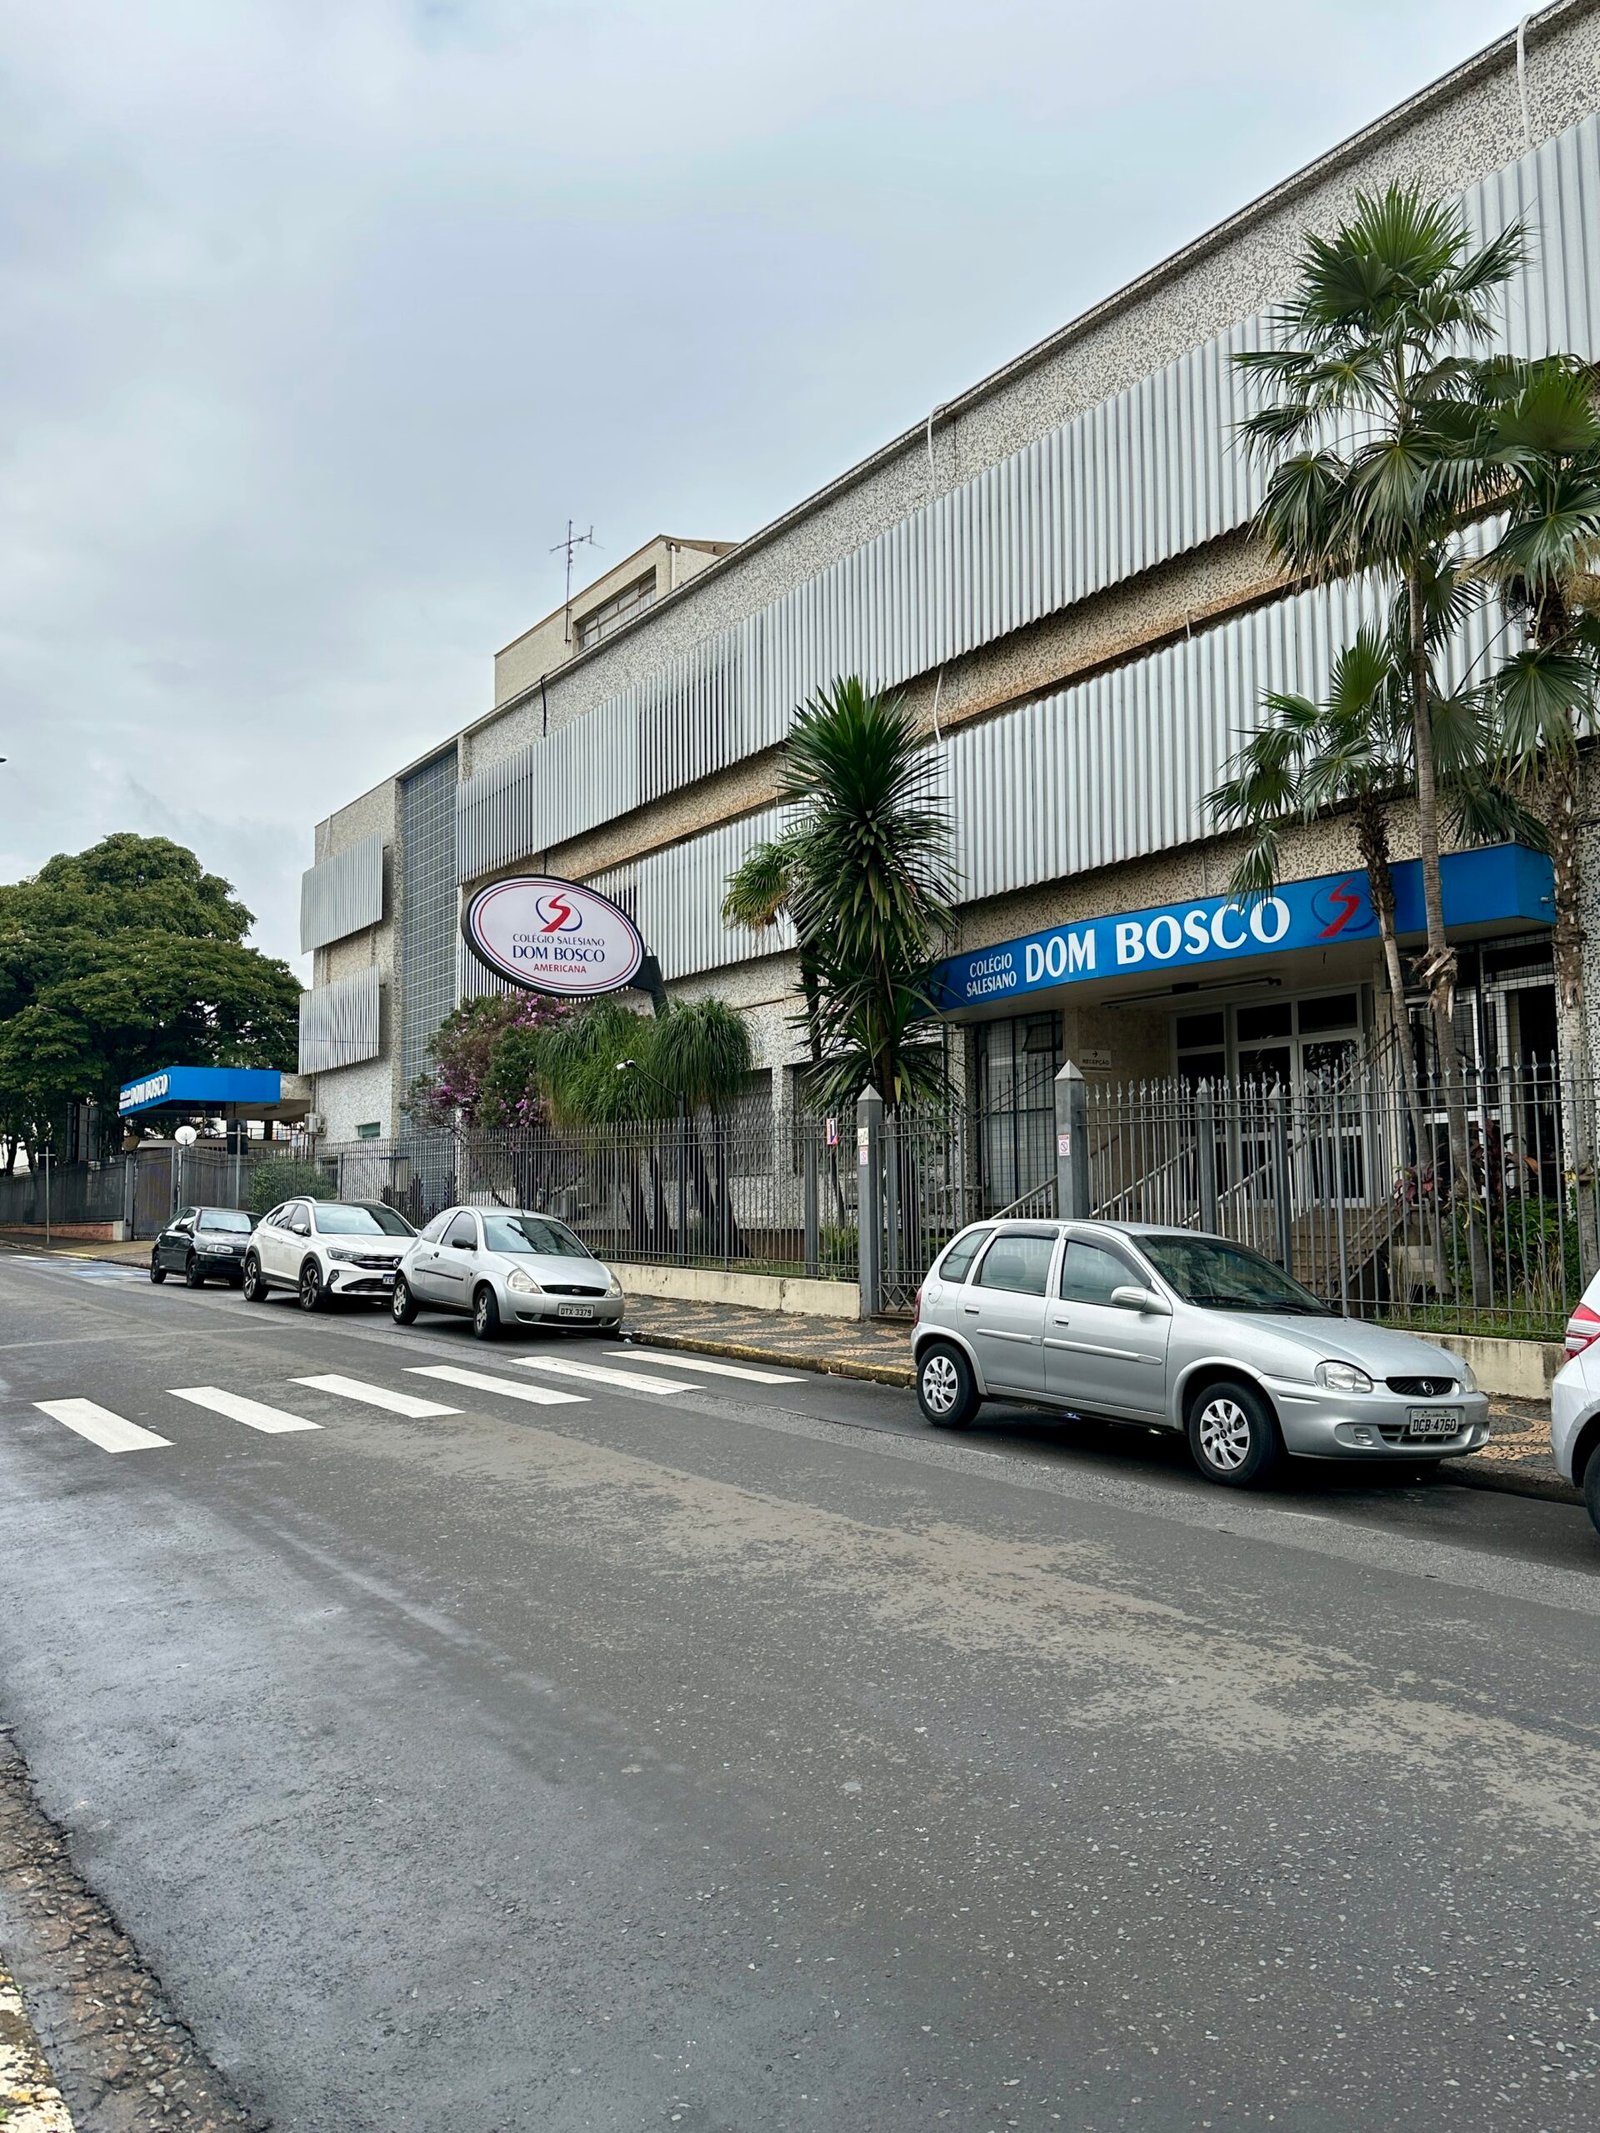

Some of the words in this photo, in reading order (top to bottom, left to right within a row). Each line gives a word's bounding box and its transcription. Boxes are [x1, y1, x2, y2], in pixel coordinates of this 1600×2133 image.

[512, 931, 555, 944] COLÉGIO
[557, 936, 605, 947] SALESIANO
[1025, 928, 1096, 984] DOM
[1115, 896, 1291, 965] BOSCO
[512, 945, 548, 960] DOM
[554, 946, 605, 963] BOSCO
[969, 951, 1013, 978] COLÉGIO
[533, 963, 587, 974] AMERICANA
[966, 971, 1017, 998] SALESIANO
